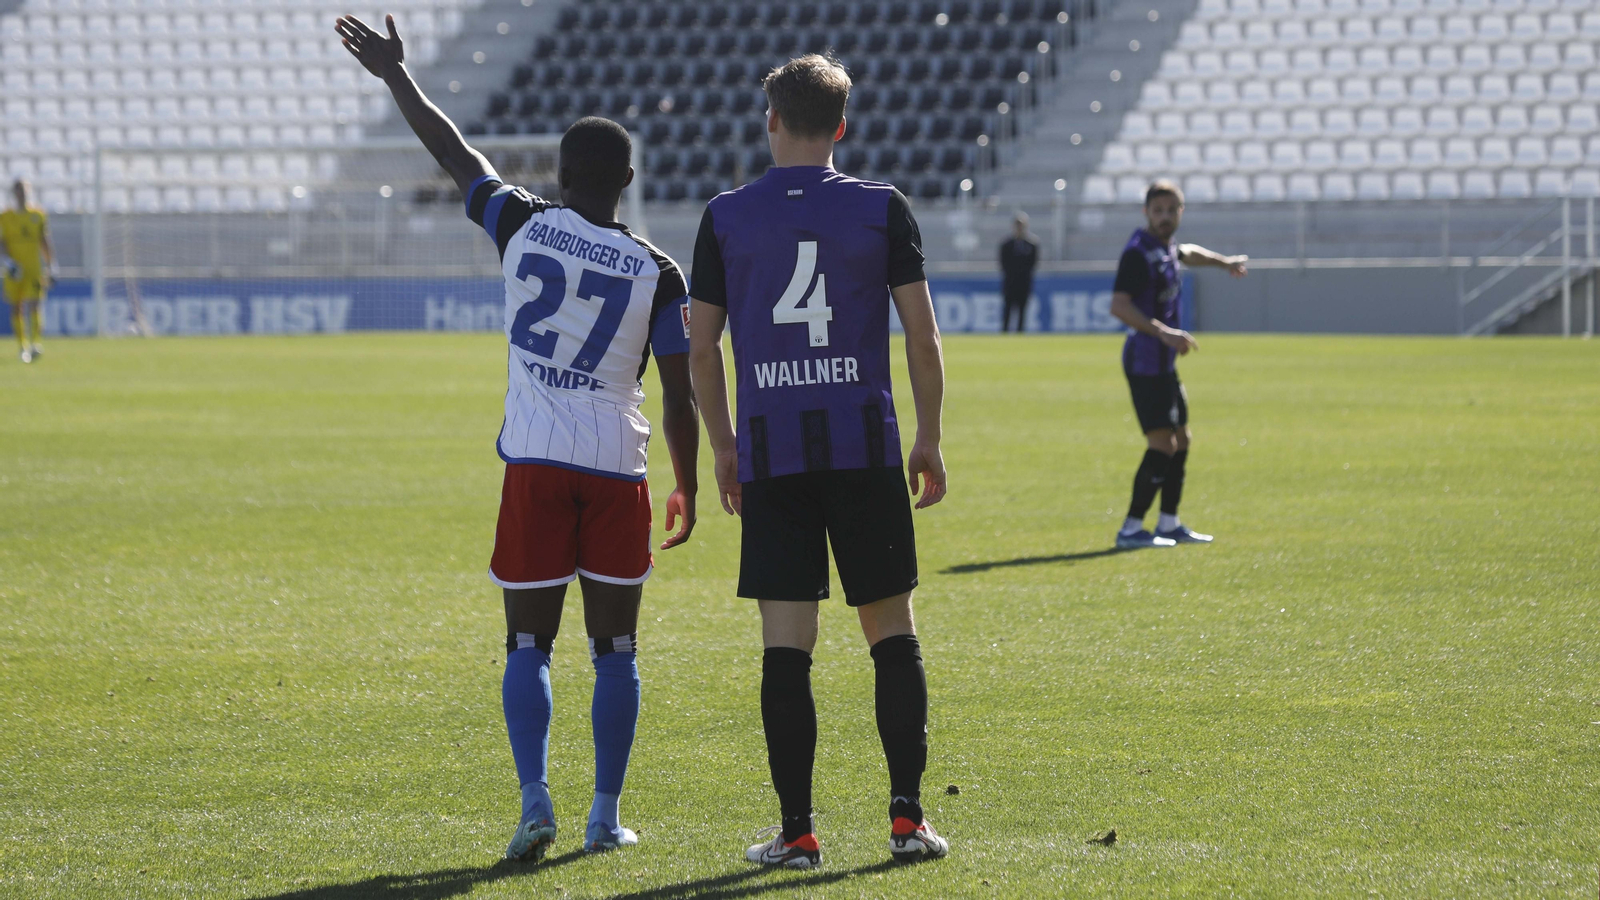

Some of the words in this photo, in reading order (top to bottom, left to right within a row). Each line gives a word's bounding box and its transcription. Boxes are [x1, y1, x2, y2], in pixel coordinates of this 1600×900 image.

[526, 221, 618, 270] HAMBURGER
[621, 254, 645, 277] SV
[146, 296, 240, 333] DER
[251, 295, 353, 333] HSV
[510, 252, 634, 374] 27
[772, 240, 833, 347] 4
[1051, 291, 1122, 333] HS
[753, 356, 860, 389] WALLNER
